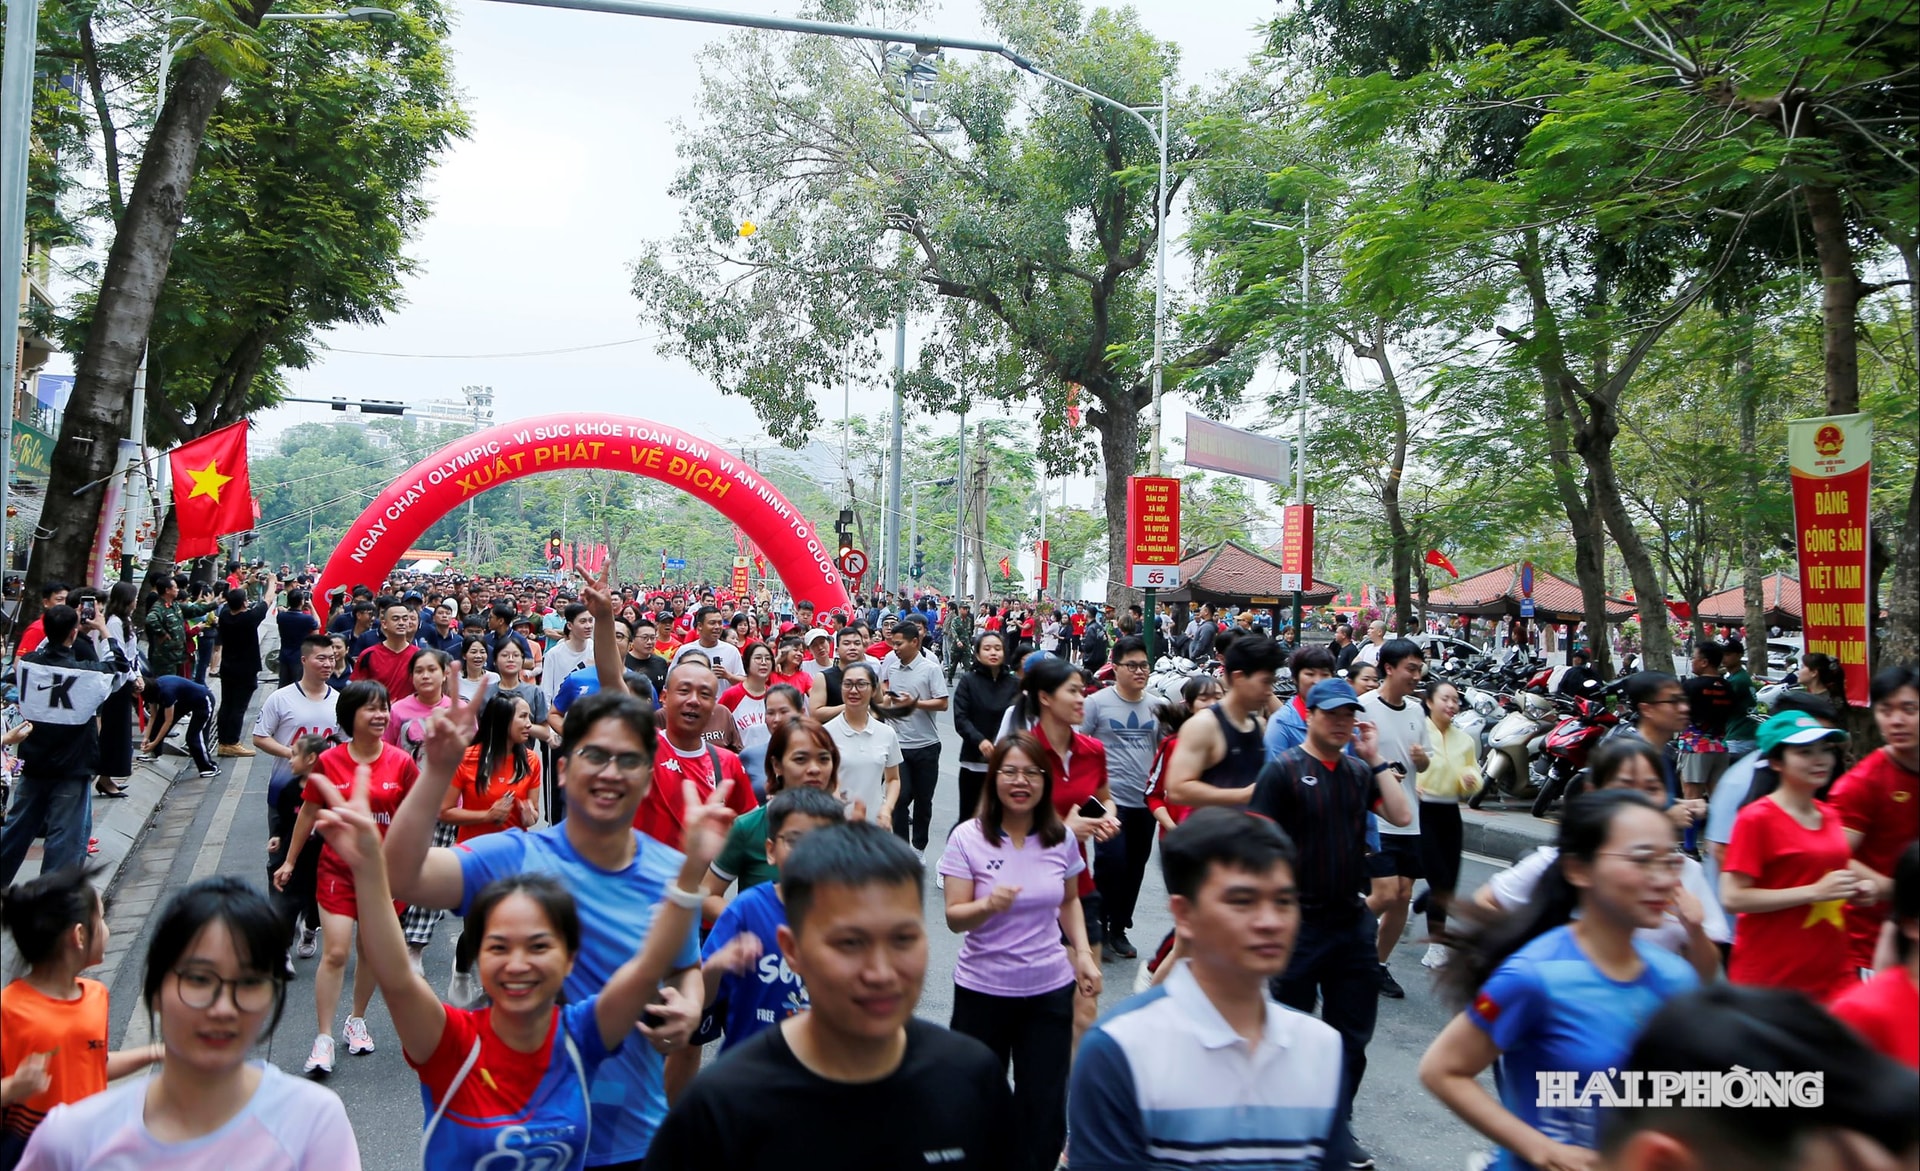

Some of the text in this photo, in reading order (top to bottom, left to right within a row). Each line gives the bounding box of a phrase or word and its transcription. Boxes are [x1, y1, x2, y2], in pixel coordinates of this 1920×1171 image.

[386, 480, 427, 520] CHẠY
[428, 441, 500, 485] OLYMPIC
[535, 423, 571, 441] SỨC
[734, 471, 758, 490] AN
[757, 485, 791, 520] NINH
[456, 451, 525, 497] XUẤT
[535, 439, 605, 466] PHÁT
[668, 456, 732, 498] ĐÍCH
[1815, 483, 1849, 515] ĐẢNG
[1804, 519, 1863, 558] CỘNG SẢN
[1148, 572, 1164, 584] 5G
[1808, 561, 1861, 594] VIỆT NAM
[1806, 603, 1840, 628] QUANG
[1840, 636, 1866, 665] NĂM!
[736, 713, 757, 731] NEW
[756, 1008, 776, 1024] FREE
